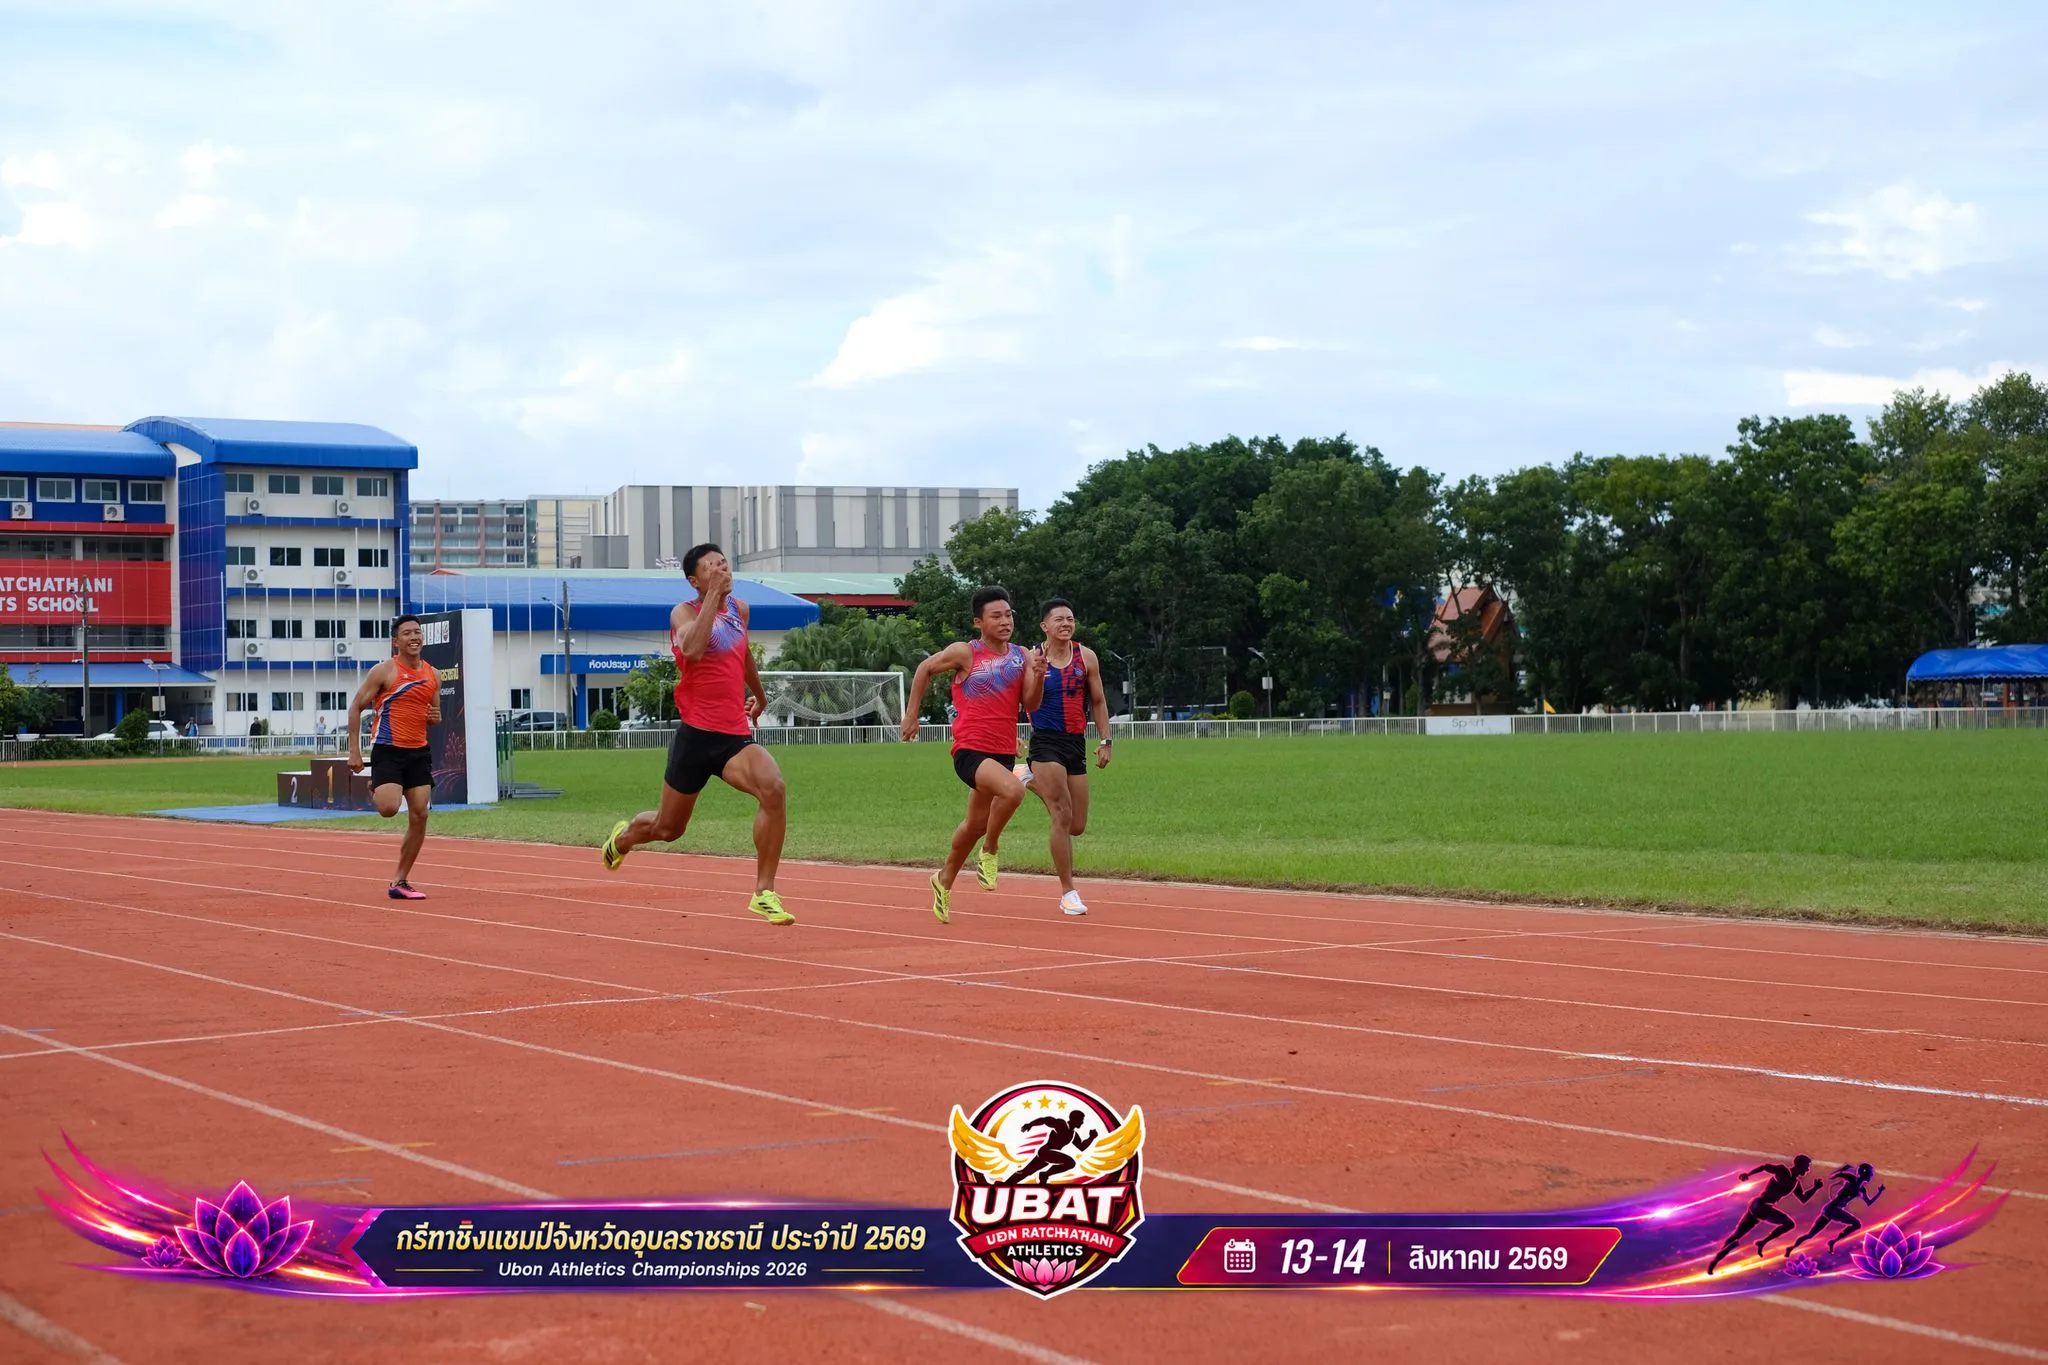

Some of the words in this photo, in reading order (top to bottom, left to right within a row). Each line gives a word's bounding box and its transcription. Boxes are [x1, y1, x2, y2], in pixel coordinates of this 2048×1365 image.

[27, 596, 98, 612] SCHOOL
[589, 659, 630, 671] ห้องประชุม
[291, 776, 299, 804] 2
[327, 765, 334, 804] 1
